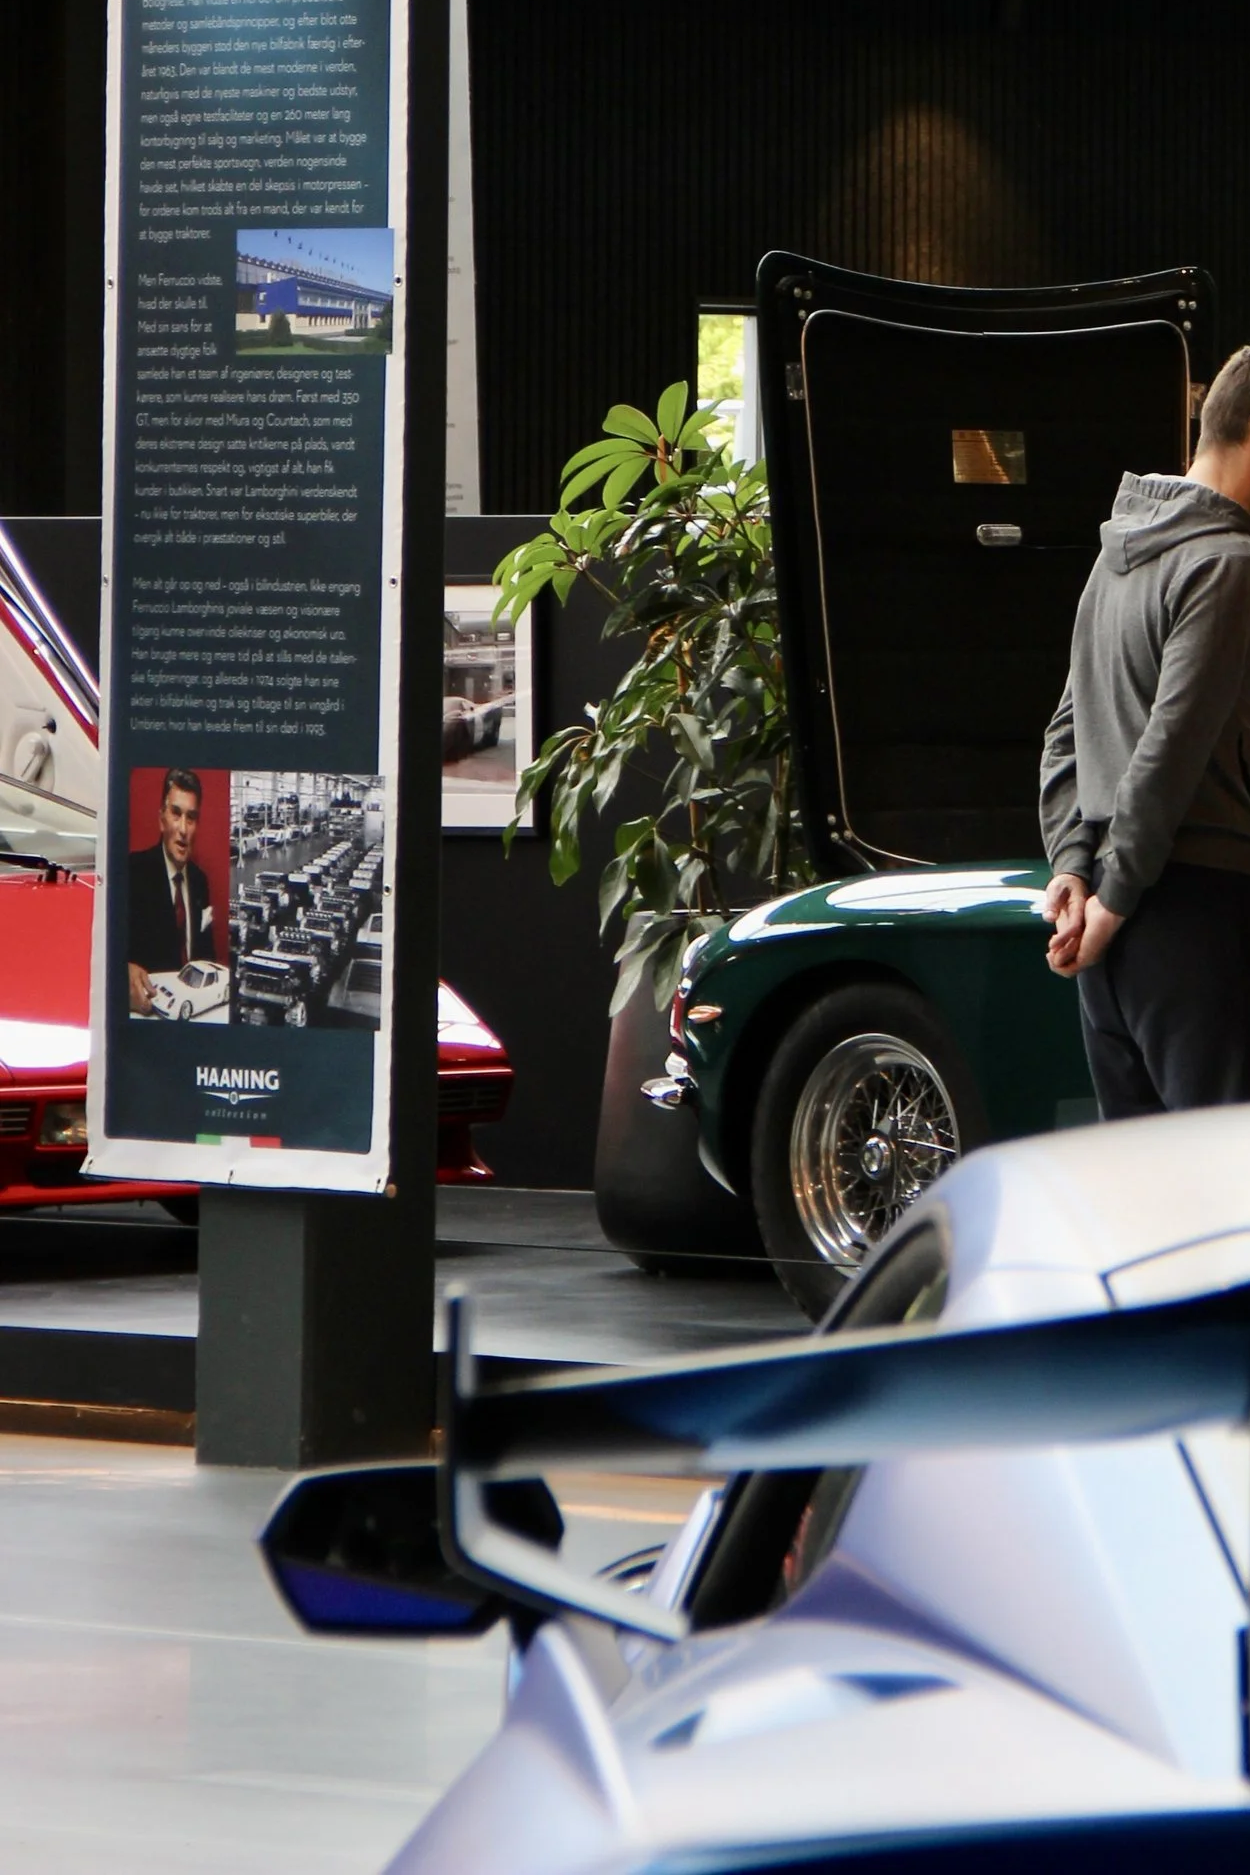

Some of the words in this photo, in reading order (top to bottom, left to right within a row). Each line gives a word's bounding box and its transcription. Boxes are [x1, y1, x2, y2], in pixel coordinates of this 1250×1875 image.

[142, 18, 175, 31] metoder
[177, 21, 189, 33] og
[283, 18, 296, 30] og
[297, 12, 319, 26] efter
[320, 13, 338, 26] blot
[339, 15, 358, 25] otte
[142, 40, 180, 54] måneders
[182, 39, 213, 56] byggeri
[215, 38, 232, 52] stod
[234, 38, 250, 51] den
[252, 41, 268, 53] nye
[270, 36, 305, 50] bilfabrik
[307, 35, 336, 53] færdig
[141, 87, 180, 104] naturligvis
[181, 86, 201, 99] med
[201, 86, 213, 99] de
[215, 88, 241, 100] nyeste
[243, 84, 281, 98] maskiner
[282, 88, 296, 100] og
[297, 83, 328, 97] bedste
[141, 115, 159, 124] men
[160, 108, 179, 127] også
[181, 113, 202, 126] egne
[203, 108, 254, 122] testfaciliteter
[257, 112, 269, 124] og
[271, 111, 283, 121] en
[285, 109, 303, 120] 260
[305, 110, 330, 120] meter
[332, 107, 351, 123] lang
[141, 134, 197, 150] kontorbygning
[198, 133, 206, 146] til
[208, 133, 224, 149] salg
[225, 136, 238, 149] og
[286, 131, 311, 144] Målet
[313, 134, 327, 143] var
[328, 133, 337, 143] at
[339, 130, 367, 146] bygge
[140, 157, 156, 170] den
[157, 159, 177, 170] mest
[178, 155, 212, 170] perfekte
[264, 155, 294, 168] verden
[296, 153, 347, 171] nogensinde
[140, 203, 150, 217] for
[152, 204, 181, 216] ordene
[182, 204, 200, 216] kom
[201, 203, 223, 216] trods
[224, 202, 235, 215] alt
[236, 201, 248, 215] fra
[250, 206, 262, 215] en
[292, 201, 307, 214] der
[310, 205, 323, 214] var
[325, 201, 350, 214] kendt
[352, 199, 364, 214] for
[138, 368, 169, 380] samlede
[171, 368, 186, 379] han
[188, 370, 197, 379] et
[198, 370, 219, 379] team
[220, 365, 229, 379] af
[277, 367, 319, 383] designere
[321, 370, 334, 383] og
[166, 394, 182, 403] som
[184, 390, 209, 403] kunne
[211, 390, 245, 403] realisere
[247, 391, 267, 403] hans
[296, 389, 319, 403] Først
[320, 390, 340, 403] med
[342, 393, 360, 405] 350
[152, 417, 169, 426] men
[171, 412, 182, 426] for
[184, 415, 204, 426] alvor
[205, 414, 225, 426] med
[226, 414, 250, 427] Miura
[252, 417, 265, 430] og
[313, 417, 331, 427] som
[333, 415, 353, 427] med
[136, 437, 158, 450] deres
[159, 437, 196, 450] ekstreme
[198, 437, 225, 454] design
[227, 440, 247, 450] satte
[249, 437, 289, 450] kritikerne
[291, 437, 303, 452] på
[331, 438, 356, 450] vandt
[135, 485, 163, 496] kunder
[206, 483, 228, 497] Snart
[230, 488, 243, 497] var
[245, 484, 299, 501] Lamborghini
[301, 485, 358, 498] verdenskendt
[196, 1066, 280, 1091] HAANING
[205, 1108, 267, 1120] collection
